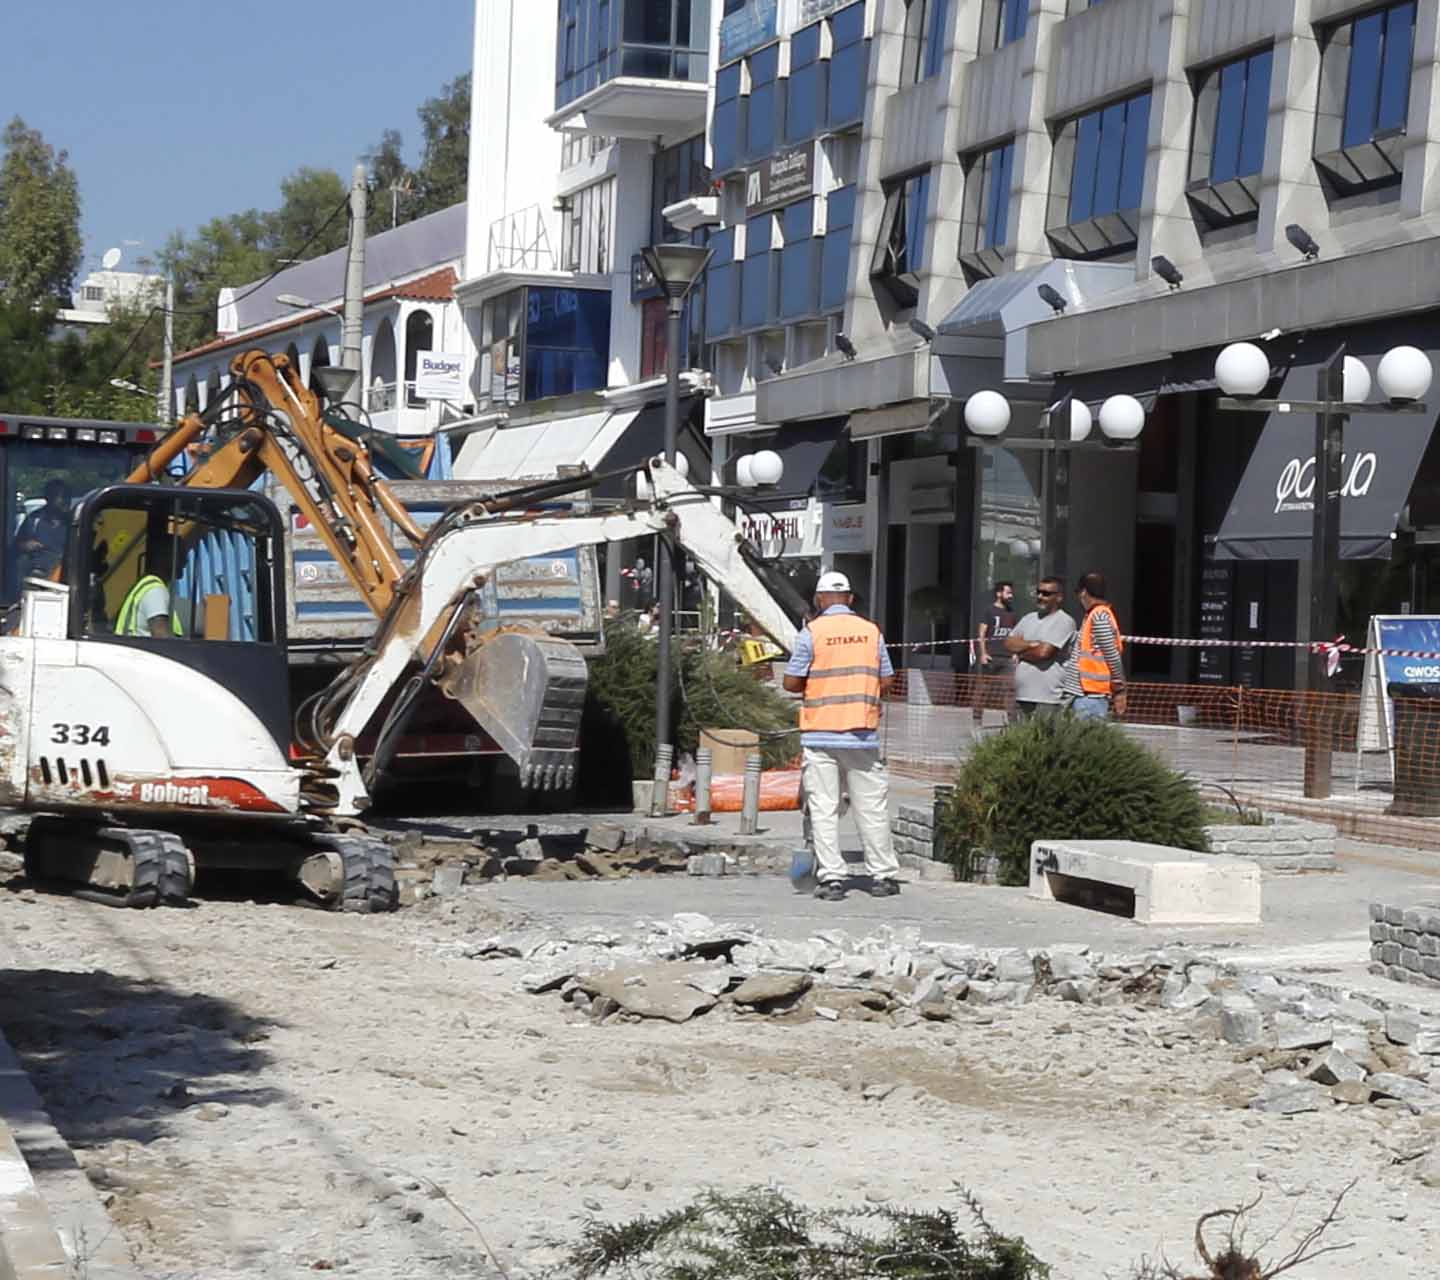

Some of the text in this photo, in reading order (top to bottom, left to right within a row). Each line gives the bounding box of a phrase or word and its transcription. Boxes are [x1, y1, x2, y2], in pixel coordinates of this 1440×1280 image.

[423, 359, 461, 373] Budget
[50, 723, 111, 747] 334
[140, 782, 209, 806] Bobcat
